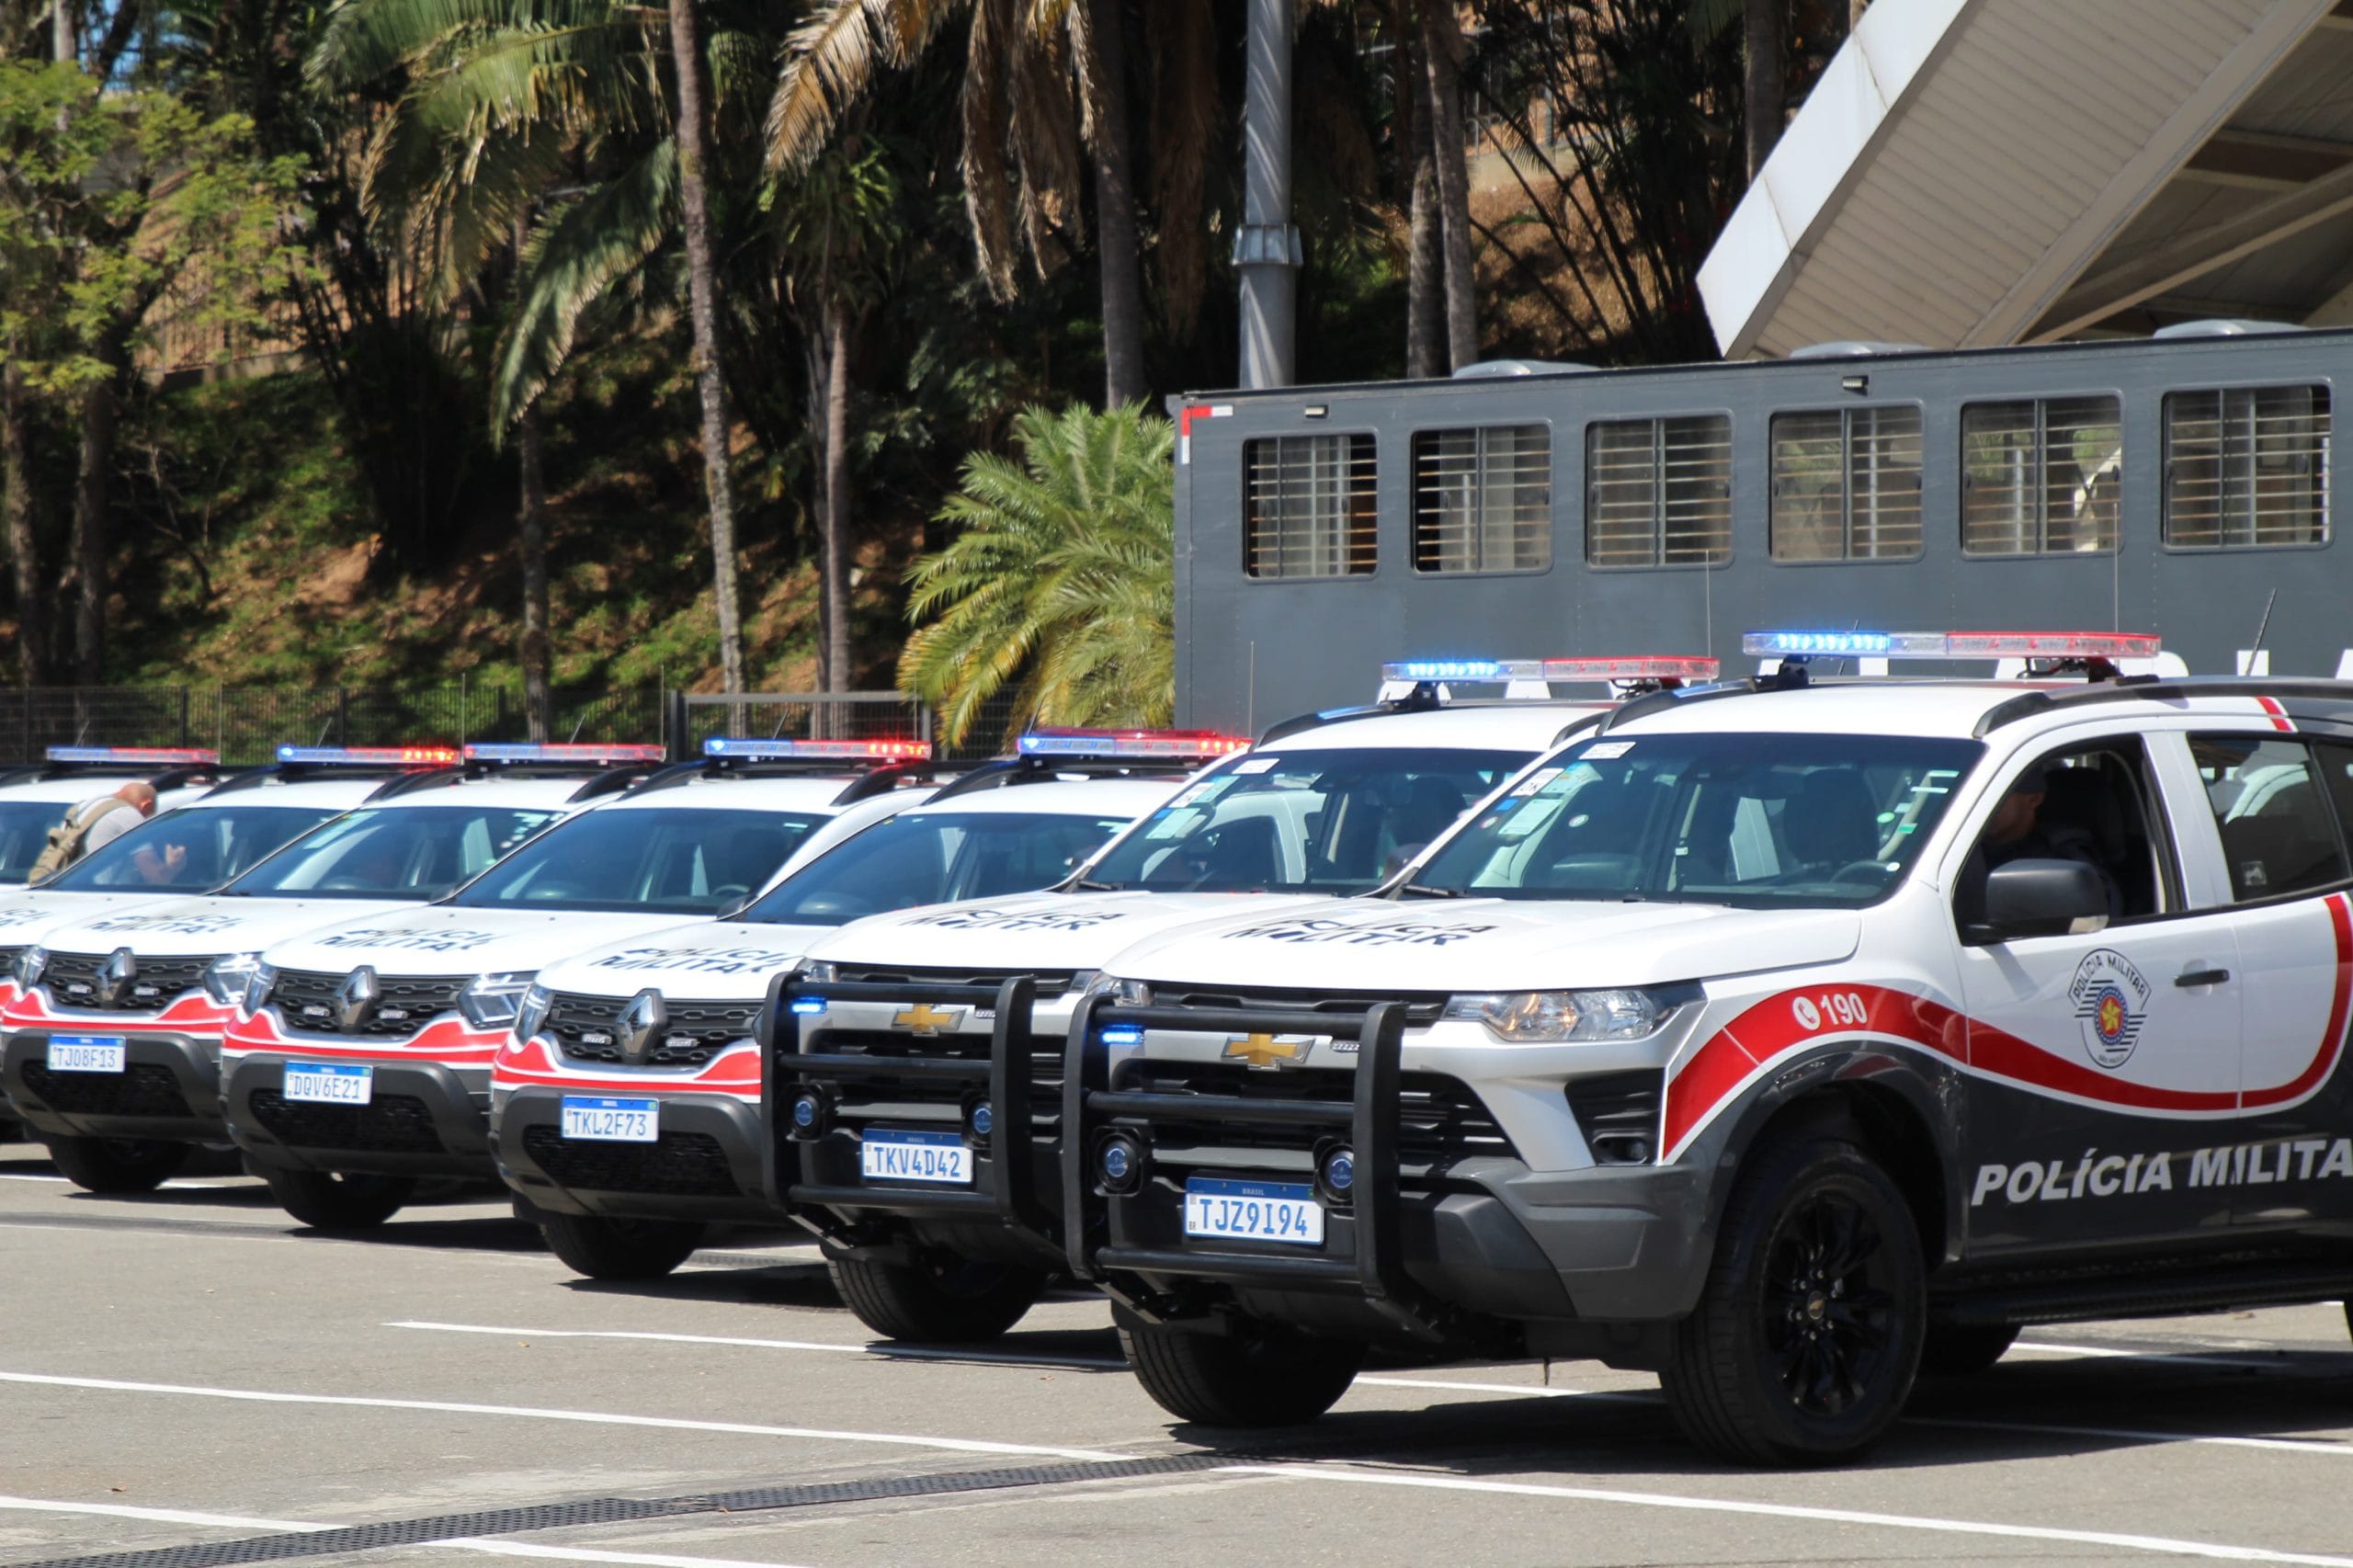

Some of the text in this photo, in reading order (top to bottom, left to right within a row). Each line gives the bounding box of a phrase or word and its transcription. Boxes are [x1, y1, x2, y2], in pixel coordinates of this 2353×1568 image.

[2107, 954, 2146, 998] MILITAR
[1821, 993, 1868, 1025] 190
[573, 1111, 647, 1136] TKL2F73
[874, 1146, 961, 1177] TKV4D42
[1971, 1148, 2173, 1207] POLÍCIA
[1242, 1187, 1265, 1197] BRASIL
[1199, 1199, 1308, 1236] TJZ9I94
